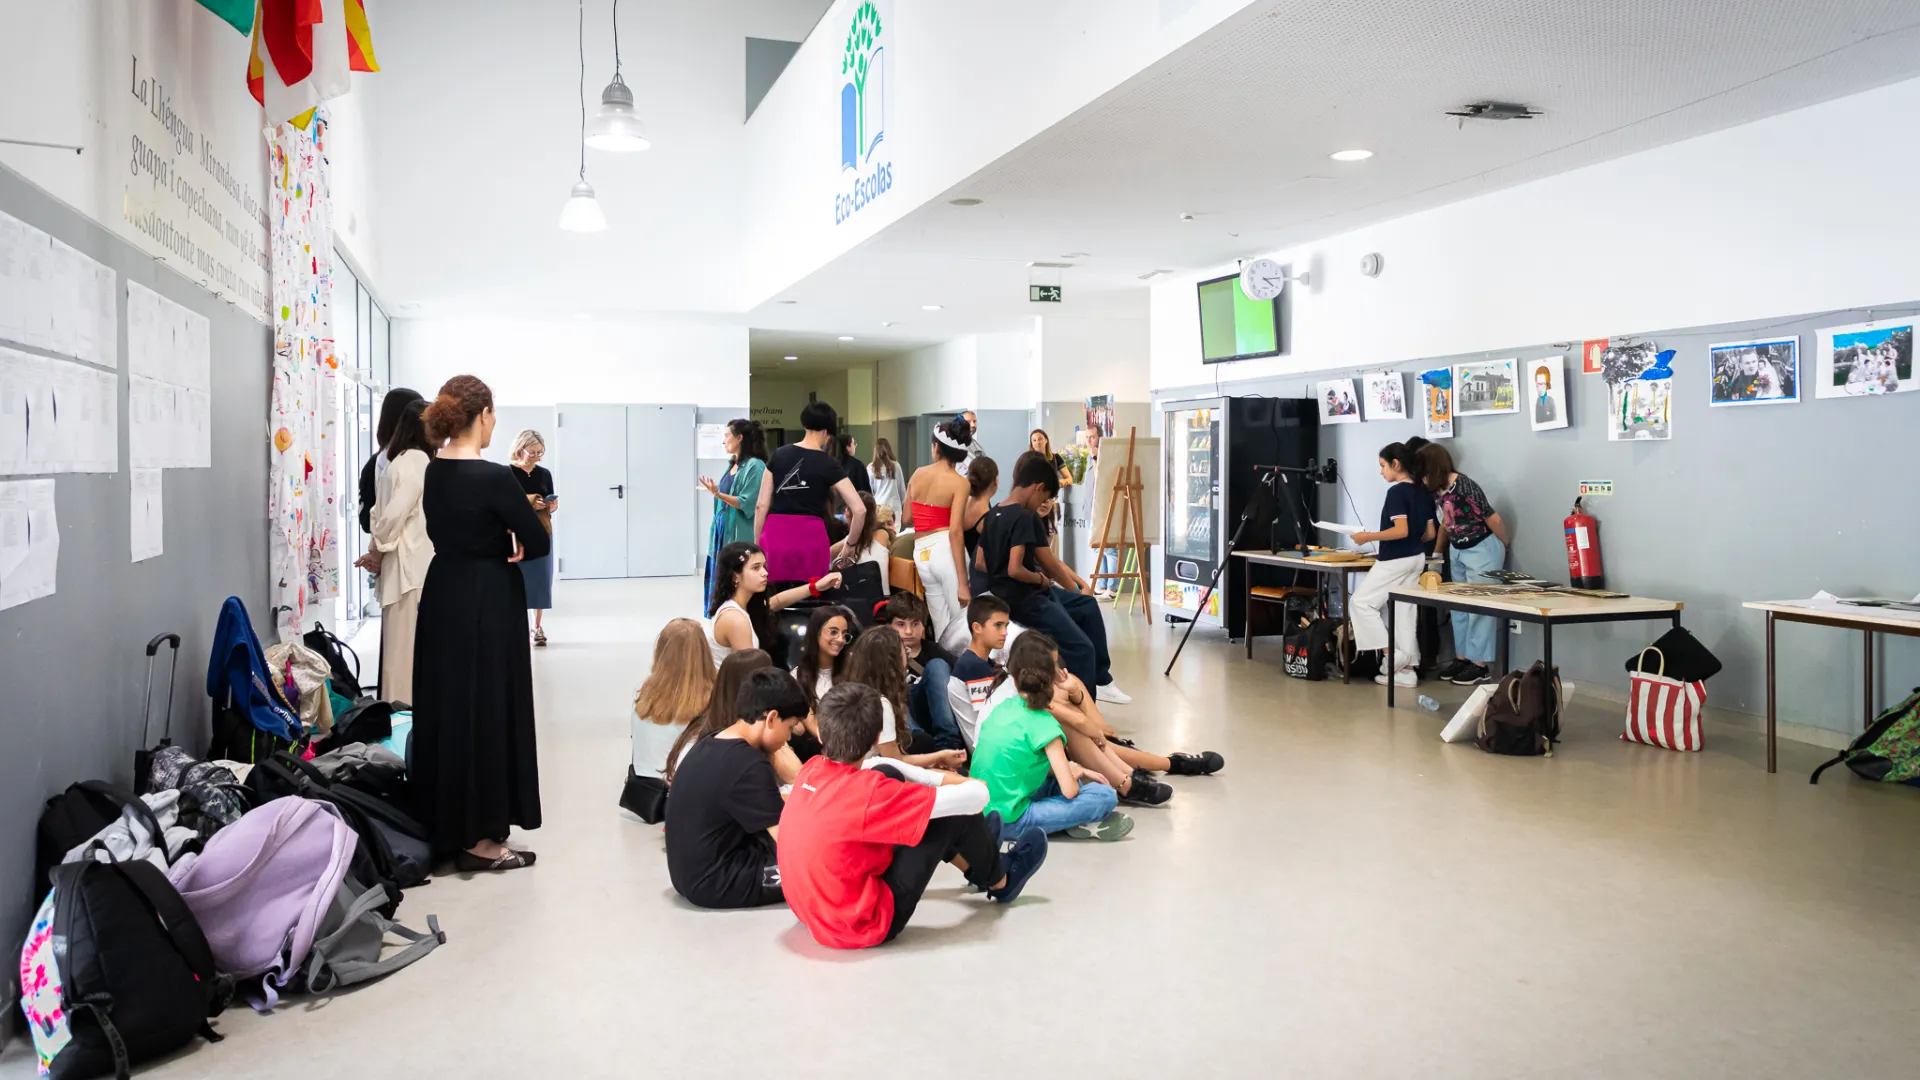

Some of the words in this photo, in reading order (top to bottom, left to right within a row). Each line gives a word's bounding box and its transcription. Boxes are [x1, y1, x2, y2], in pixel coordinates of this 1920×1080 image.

[132, 54, 147, 106] La
[151, 77, 194, 155] Lhéngua
[200, 133, 241, 208] Mirandesa,
[131, 134, 167, 191] guapa
[170, 158, 175, 193] i
[176, 175, 223, 240] capechana,
[836, 161, 892, 225] Eco-Escolas
[197, 247, 215, 278] mas
[750, 406, 782, 415] spelham
